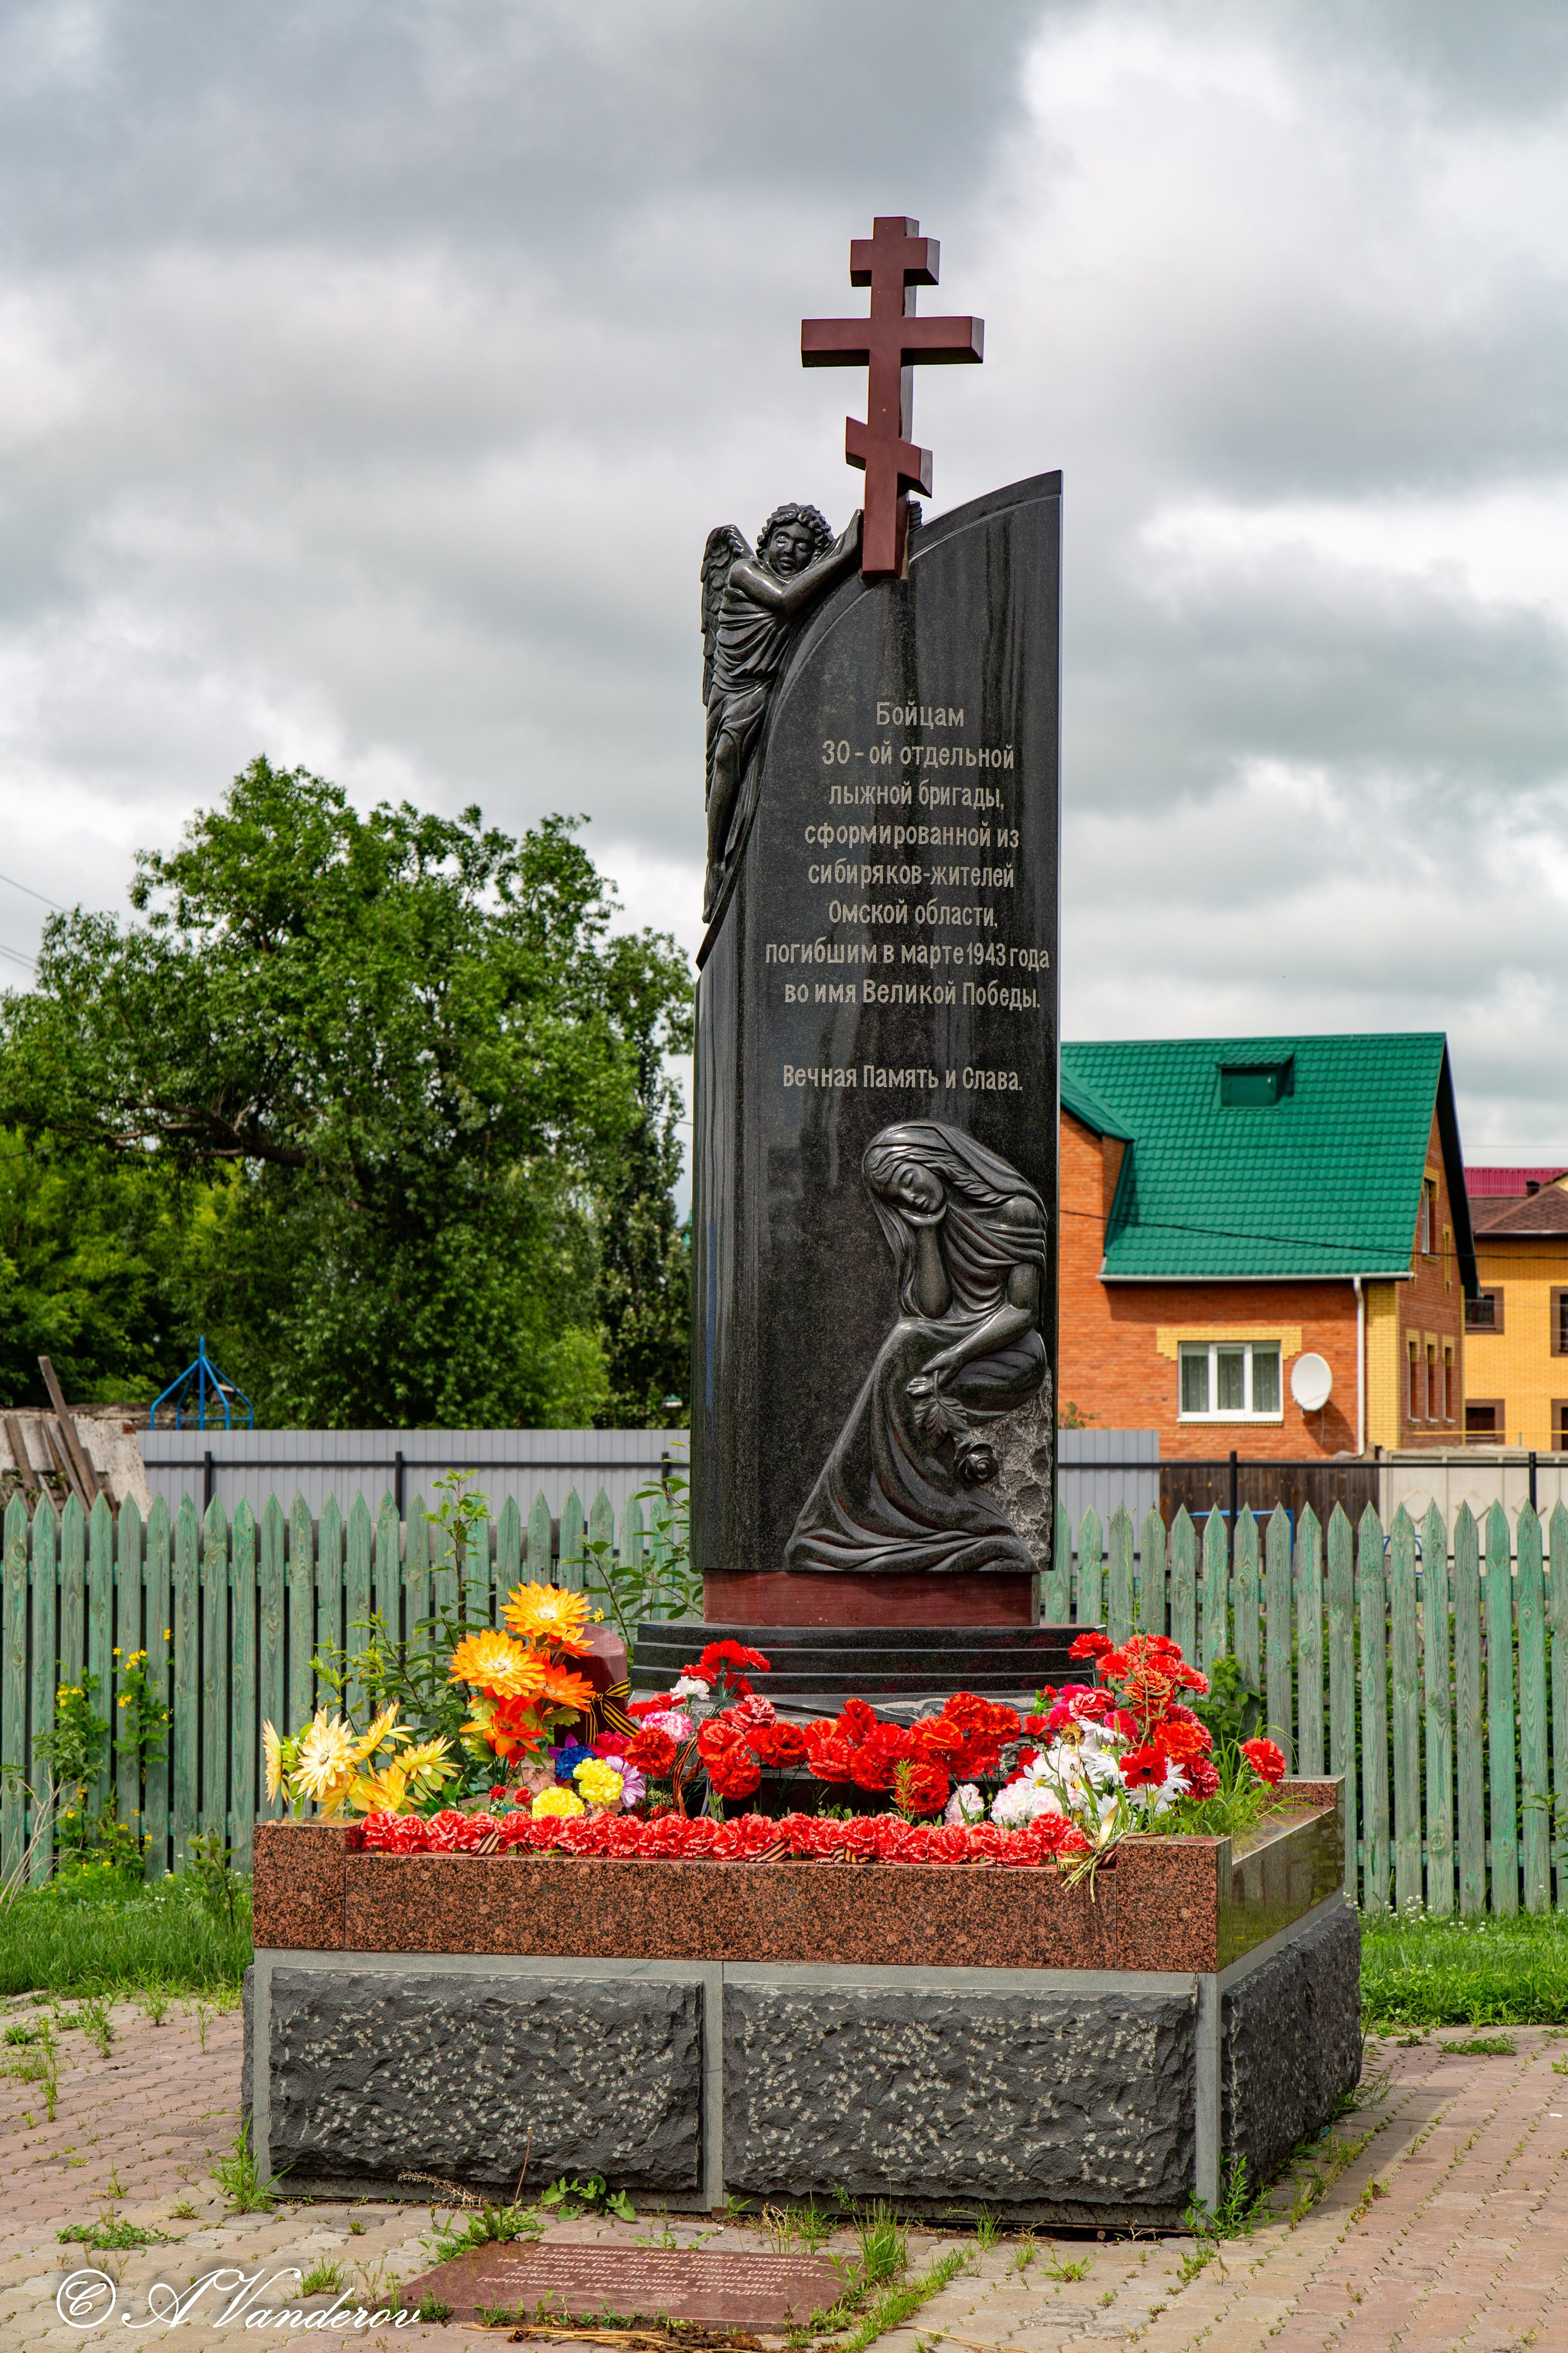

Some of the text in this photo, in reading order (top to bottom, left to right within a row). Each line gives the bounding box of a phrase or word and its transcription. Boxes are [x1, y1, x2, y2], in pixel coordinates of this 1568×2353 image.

[876, 701, 965, 730] Бойцам
[900, 744, 1014, 769] отдельной
[829, 779, 1005, 810] лыжной бригады,
[804, 821, 1019, 849] сформированной из
[808, 858, 1014, 889] сибиряков-жителей
[829, 897, 998, 929] Омской области,
[765, 936, 1049, 971] погибшим в марте 1943 года
[785, 979, 1041, 1011] во имя Великой Победы.
[783, 1065, 1023, 1091] Вечная Память и Слава.
